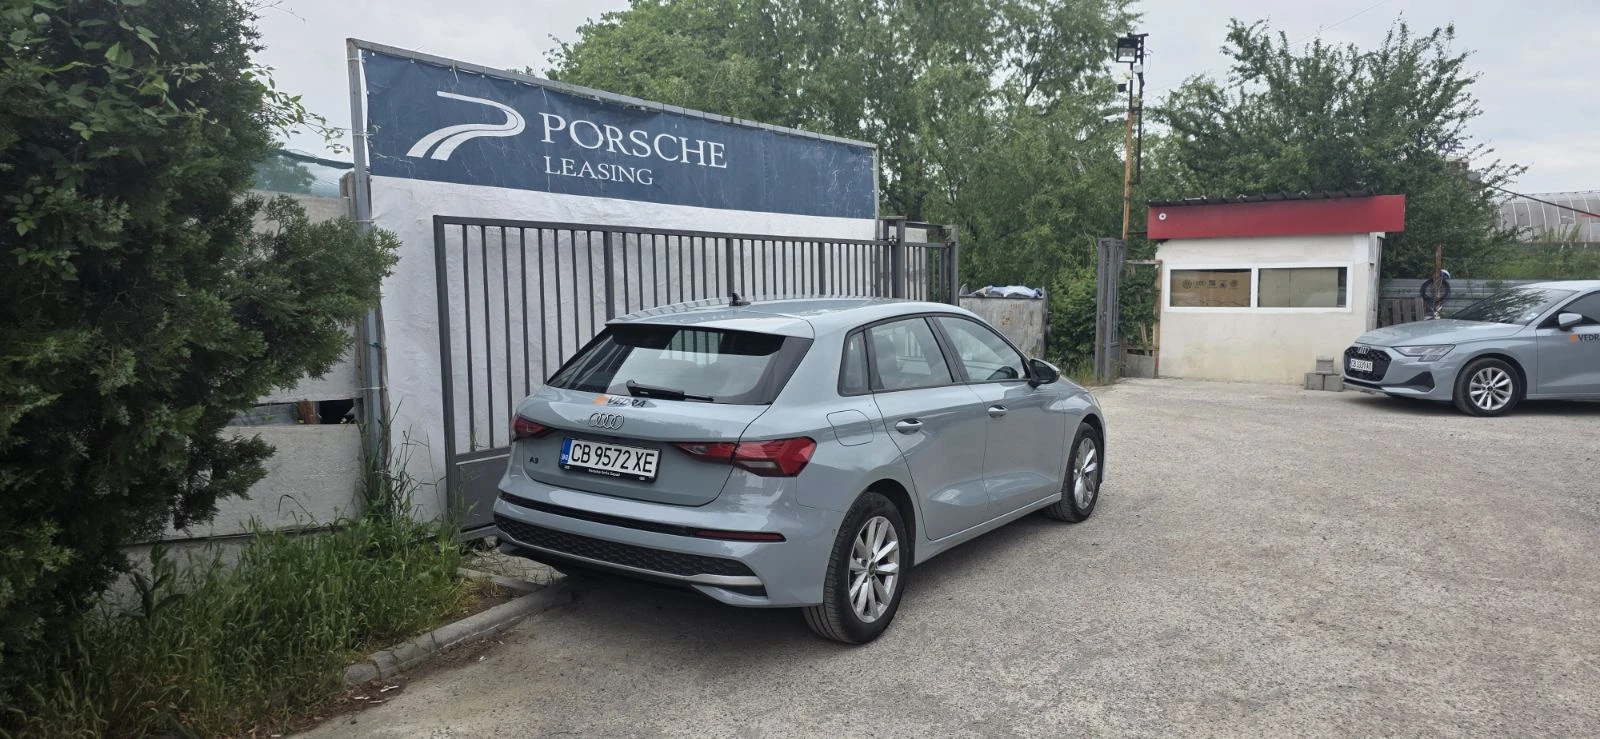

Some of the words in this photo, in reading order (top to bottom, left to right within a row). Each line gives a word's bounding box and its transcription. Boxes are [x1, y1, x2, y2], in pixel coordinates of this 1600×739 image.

[538, 112, 727, 169] PORSCHE
[543, 155, 653, 186] LEASING
[1577, 333, 1600, 342] VEDR
[607, 396, 647, 408] VEDRA
[528, 456, 539, 464] A3
[571, 443, 591, 464] CB
[594, 446, 631, 470] 9572
[632, 451, 655, 473] XE
